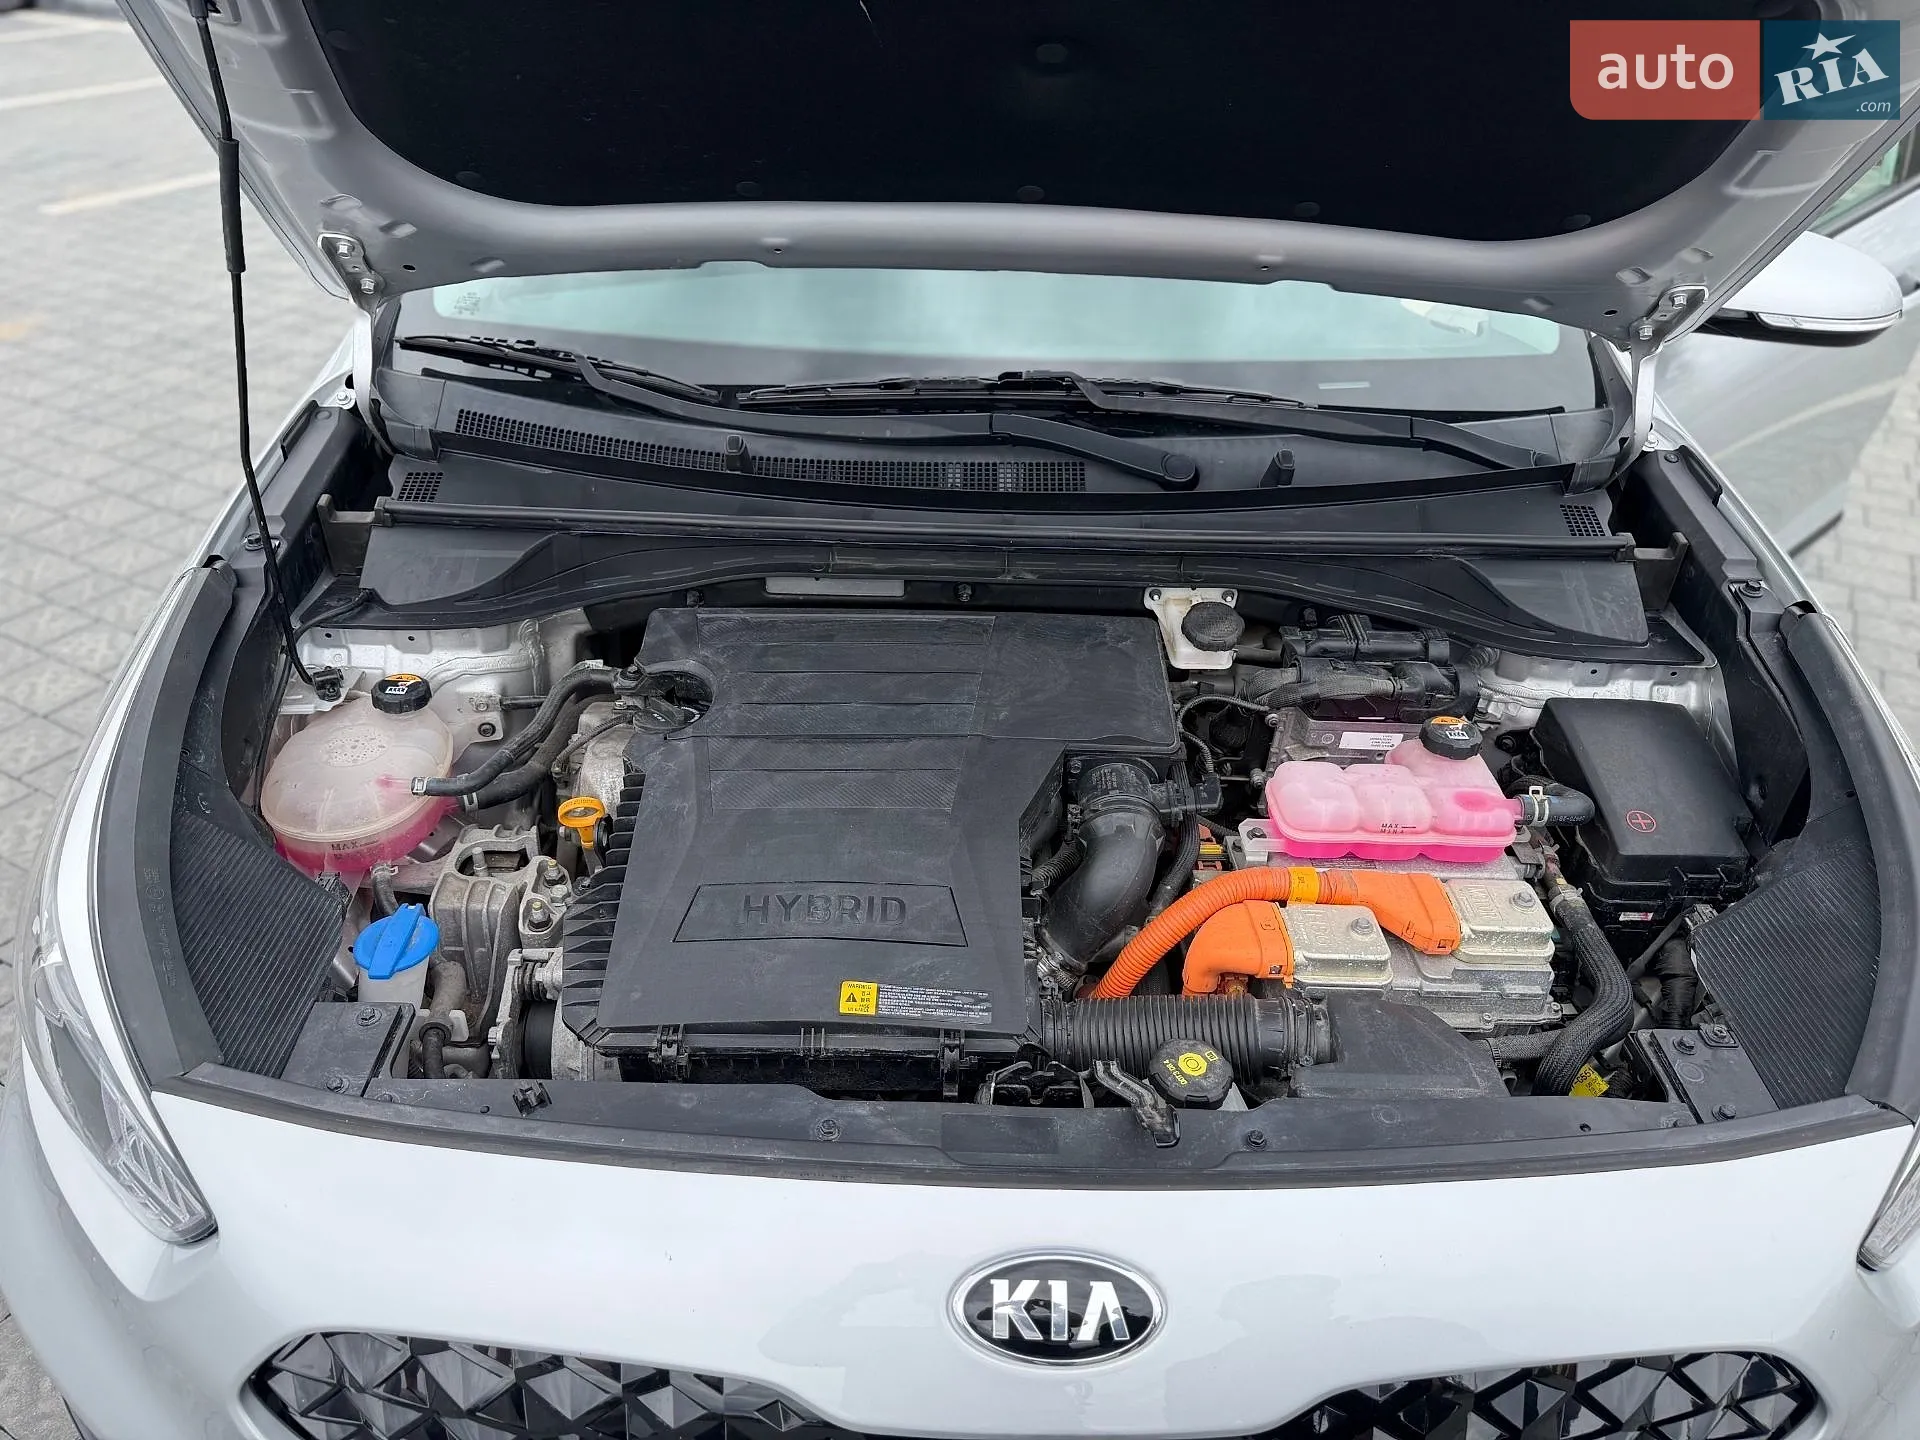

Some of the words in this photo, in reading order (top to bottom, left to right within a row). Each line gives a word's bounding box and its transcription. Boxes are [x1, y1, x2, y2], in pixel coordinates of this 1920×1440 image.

[331, 841, 358, 851] MAX
[743, 894, 907, 925] HYBRID
[990, 1279, 1130, 1341] KIA
